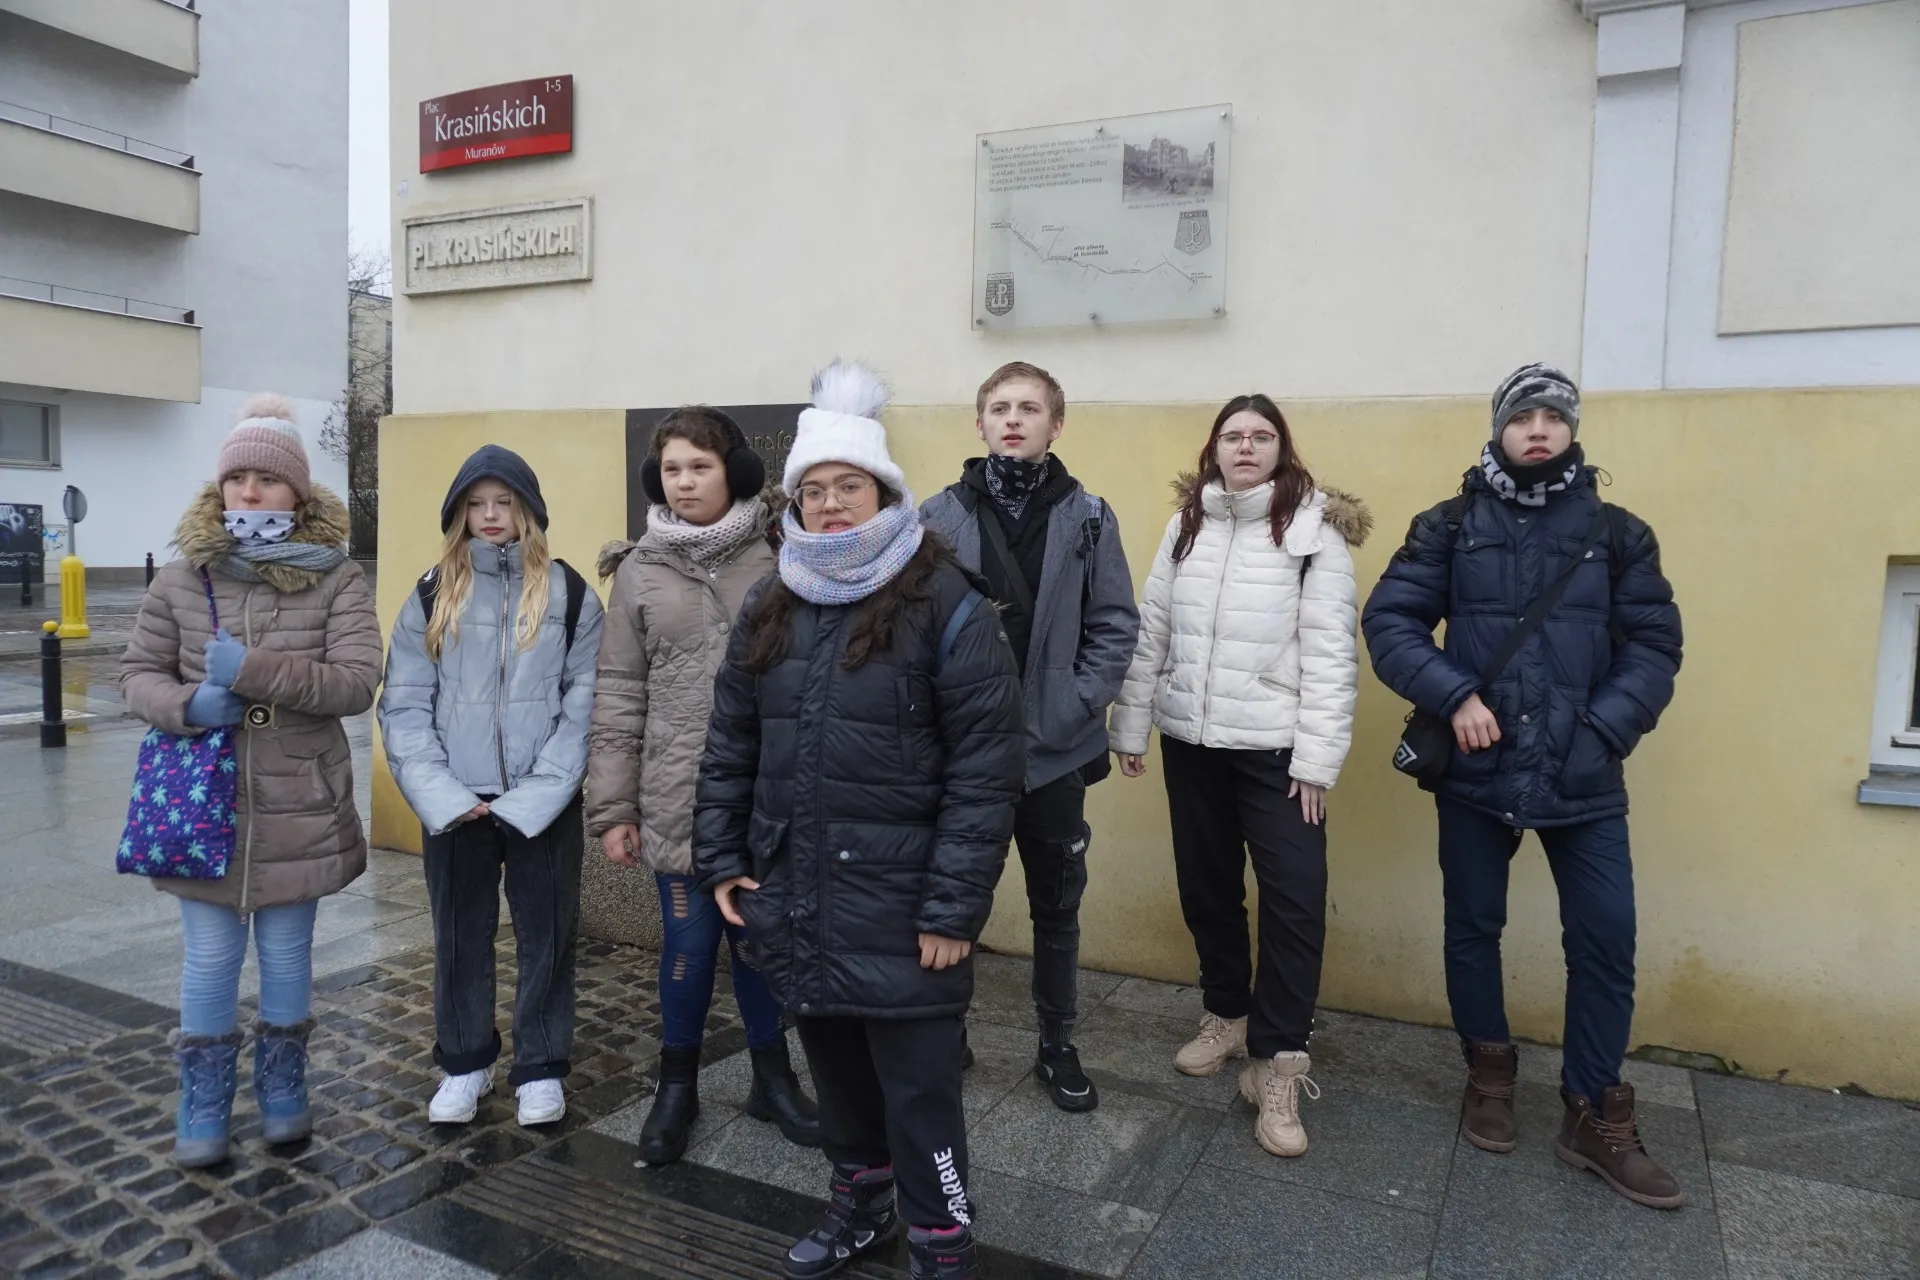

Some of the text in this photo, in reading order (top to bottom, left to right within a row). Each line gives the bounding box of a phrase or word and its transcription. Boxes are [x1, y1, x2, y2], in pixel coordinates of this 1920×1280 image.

[544, 79, 562, 93] 1-5
[424, 101, 440, 115] Plac
[435, 95, 547, 143] Krasińskich
[465, 144, 507, 160] Muranów
[443, 223, 575, 267] KRASIŃSKICH
